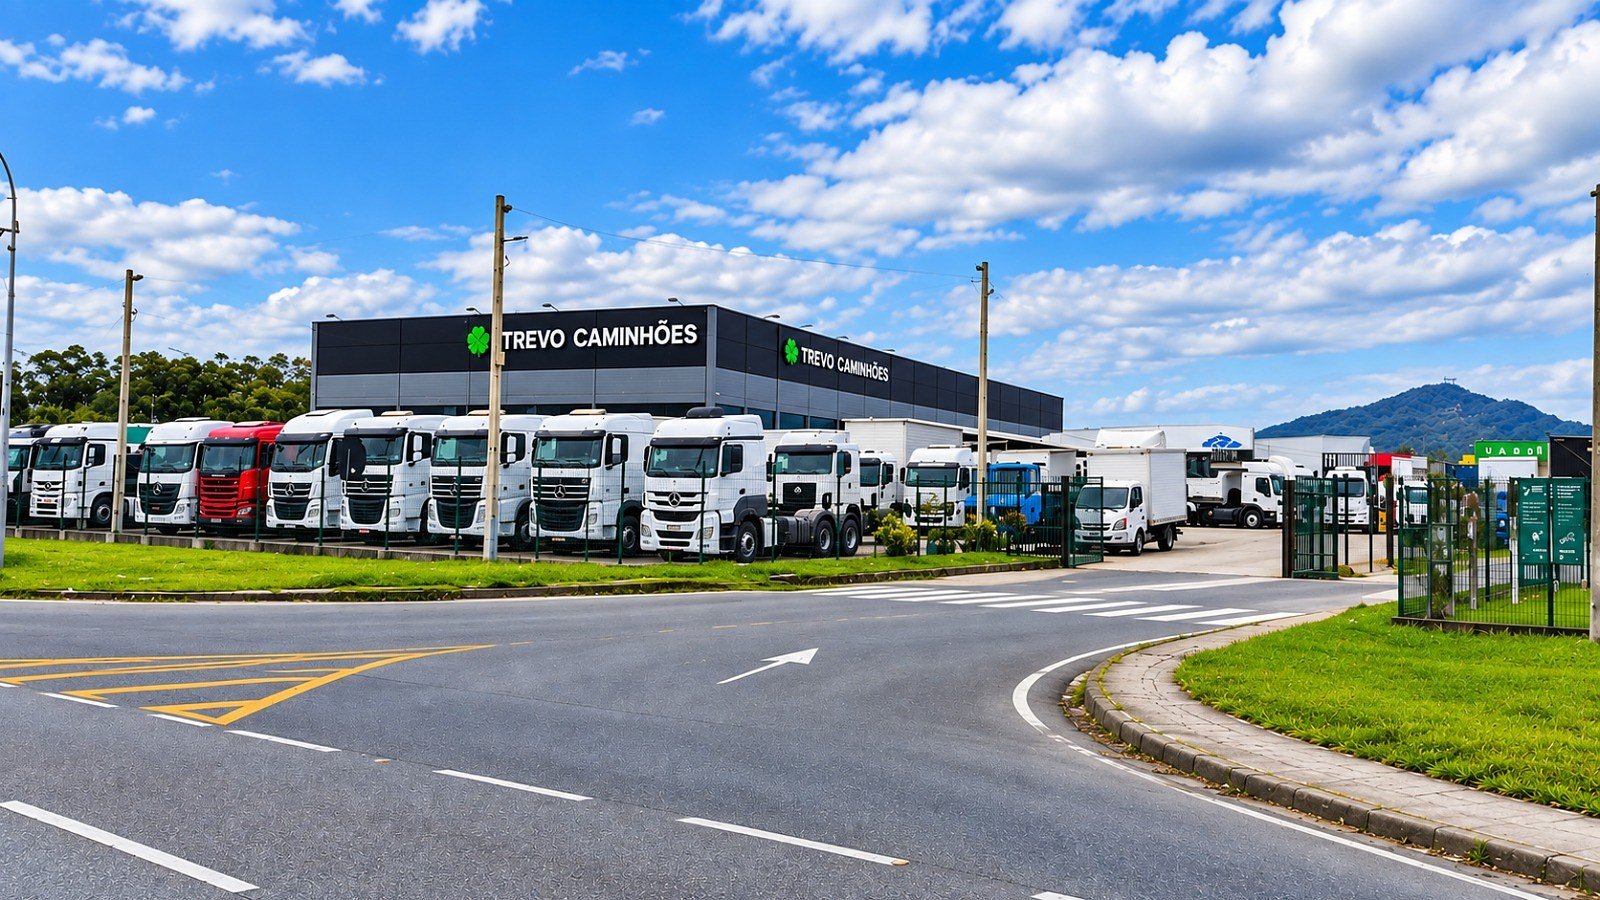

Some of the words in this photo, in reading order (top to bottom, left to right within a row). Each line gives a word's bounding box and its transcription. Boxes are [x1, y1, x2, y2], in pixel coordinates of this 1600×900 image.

[502, 329, 565, 350] TREVO
[573, 320, 697, 347] CAMINHÕES
[801, 347, 834, 370] TREVO
[837, 357, 889, 382] CAMINHÕES
